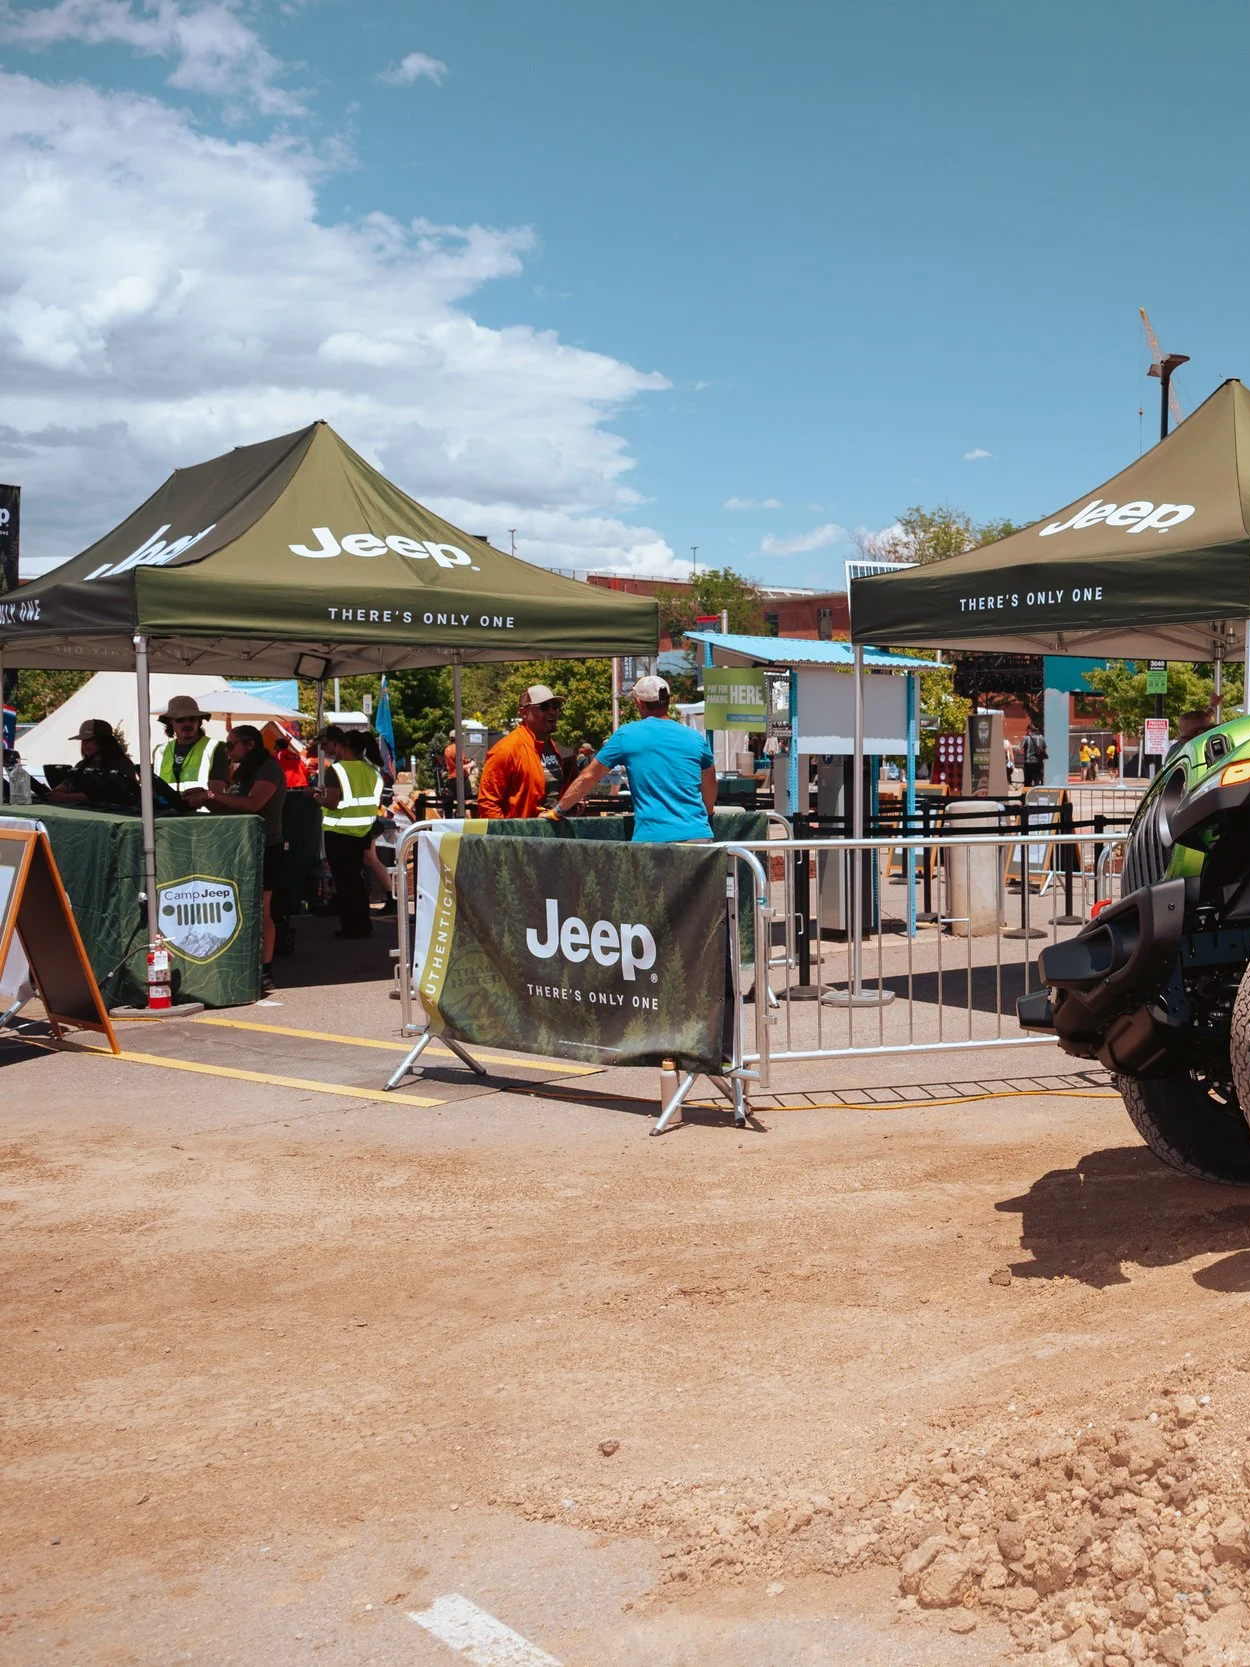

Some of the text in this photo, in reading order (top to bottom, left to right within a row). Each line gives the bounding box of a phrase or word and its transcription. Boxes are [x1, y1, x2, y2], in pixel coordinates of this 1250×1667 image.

[1039, 499, 1195, 536] Jeep
[288, 527, 473, 569] Jeep
[19, 599, 41, 622] ONE
[960, 586, 1103, 611] THERE'S ONLY ONE
[328, 607, 515, 628] THERE'S ONLY ONE
[730, 685, 764, 705] HERE
[425, 863, 454, 1006] AUTHENTICITY
[526, 899, 657, 981] Jeep
[527, 984, 659, 1010] THERE'S ONLY ONE
